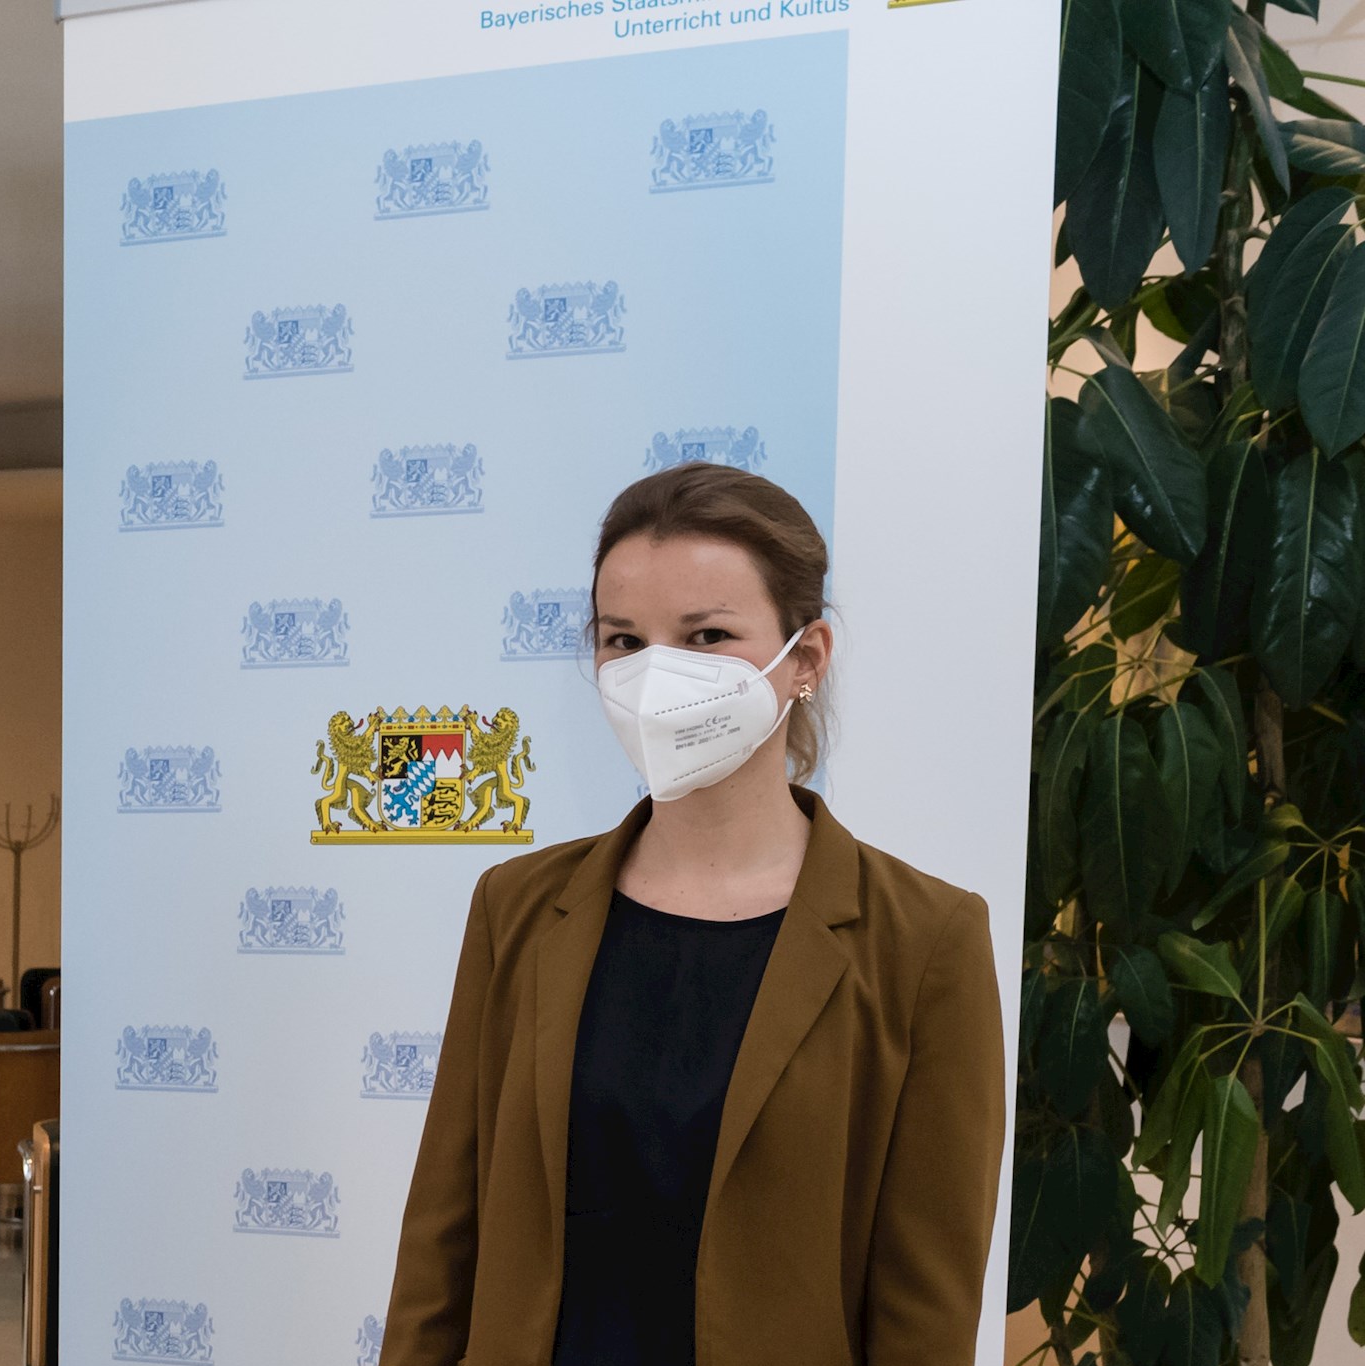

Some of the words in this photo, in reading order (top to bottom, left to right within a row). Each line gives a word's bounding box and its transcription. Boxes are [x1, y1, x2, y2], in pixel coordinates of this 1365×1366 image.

[481, 1, 604, 30] Bayerisches
[614, 10, 722, 38] Unterricht
[730, 6, 770, 24] und
[780, 0, 850, 18] Kultus
